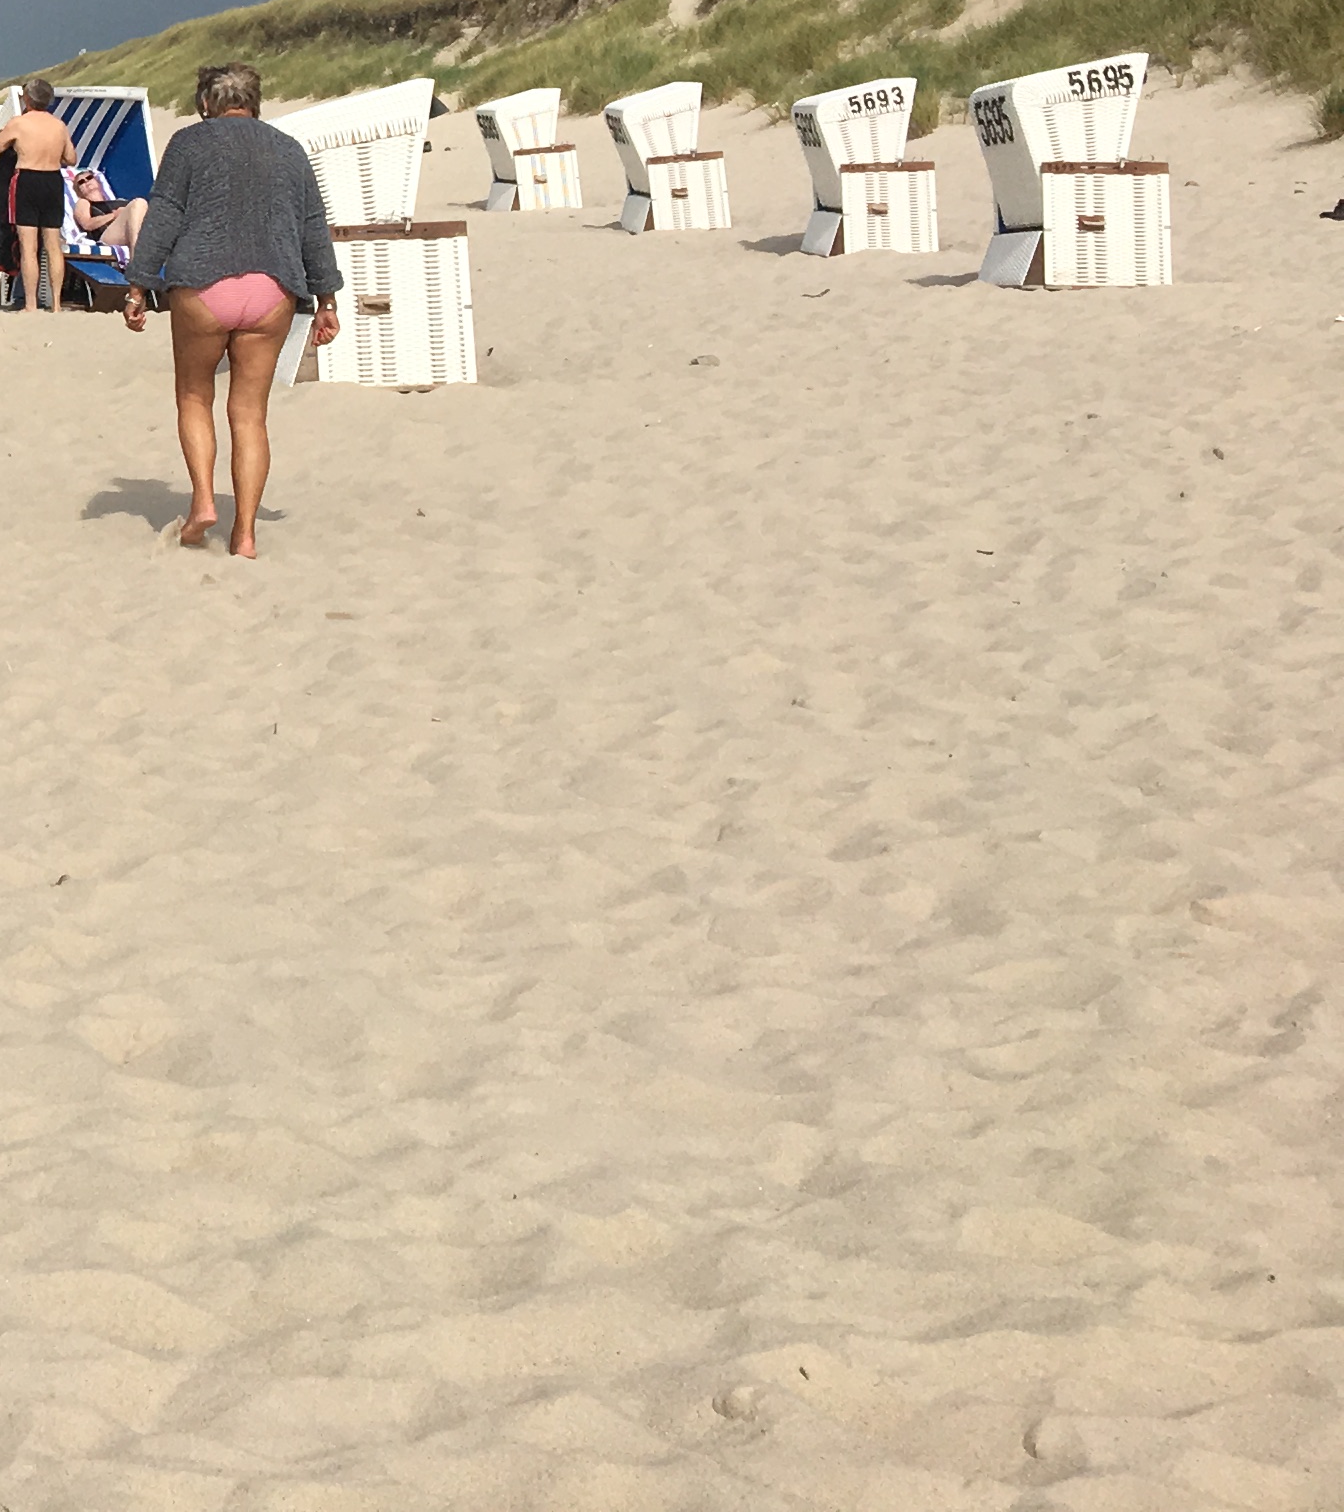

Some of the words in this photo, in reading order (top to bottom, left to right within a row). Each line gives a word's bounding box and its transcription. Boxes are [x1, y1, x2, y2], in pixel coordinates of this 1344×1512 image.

[1068, 64, 1134, 96] 5695
[847, 86, 904, 114] 5693
[974, 95, 1014, 146] 5695
